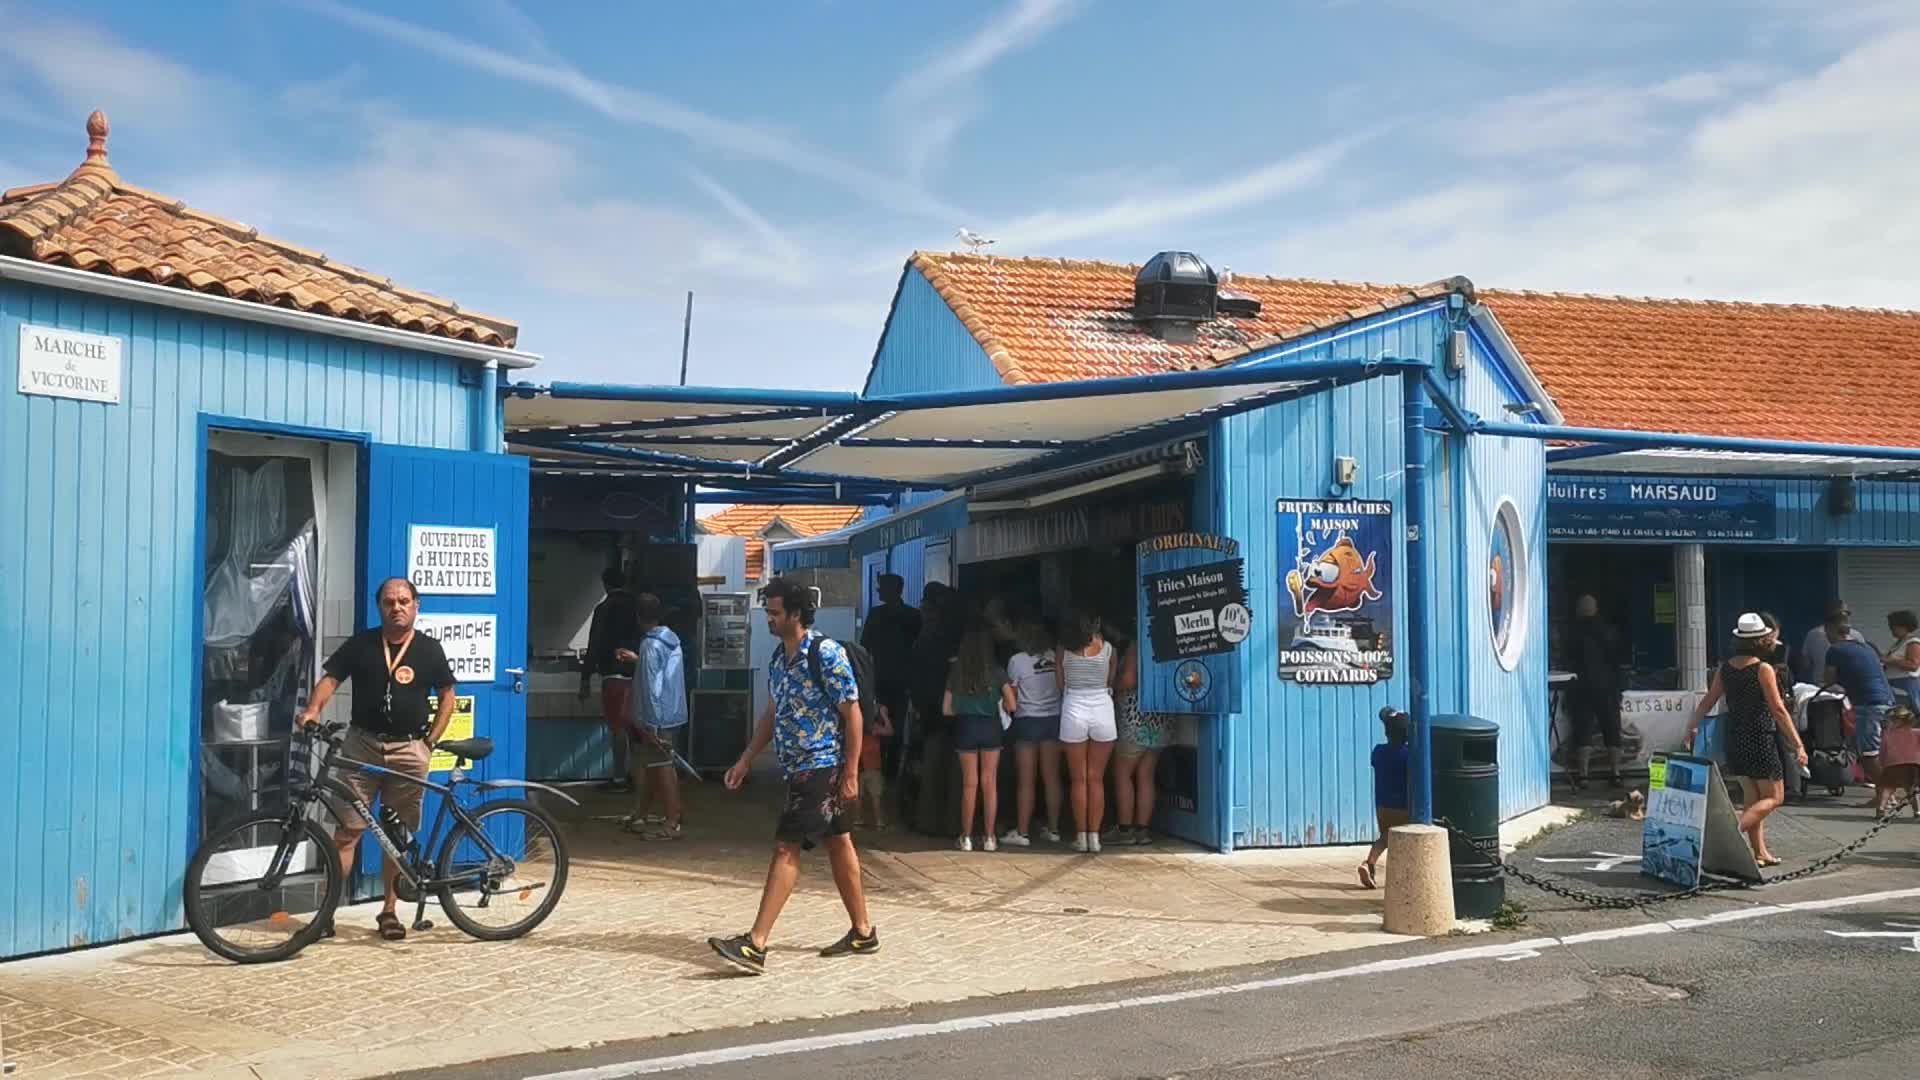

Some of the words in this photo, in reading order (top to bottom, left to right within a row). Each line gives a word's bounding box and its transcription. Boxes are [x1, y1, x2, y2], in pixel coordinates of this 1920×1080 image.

[34, 335, 107, 360] MARCHÉ
[32, 371, 108, 393] VICTORINE
[1547, 482, 1607, 500] Huitres
[1630, 484, 1717, 501] MARSAUD
[1278, 501, 1324, 513] FRITES
[1311, 518, 1360, 531] MAISON
[420, 531, 487, 549] OUVERTURE
[1152, 532, 1223, 552] ORIGINAL
[413, 569, 492, 588] GRATUITE
[1157, 578, 1186, 593] Frites
[1187, 571, 1224, 589] Maison
[424, 620, 492, 642] OURRICHE
[447, 657, 491, 674] ORTER
[1280, 650, 1352, 664] POISSONS
[1357, 651, 1393, 663] 100%
[1295, 669, 1378, 682] COTINARDS
[1620, 699, 1682, 713] arsaud
